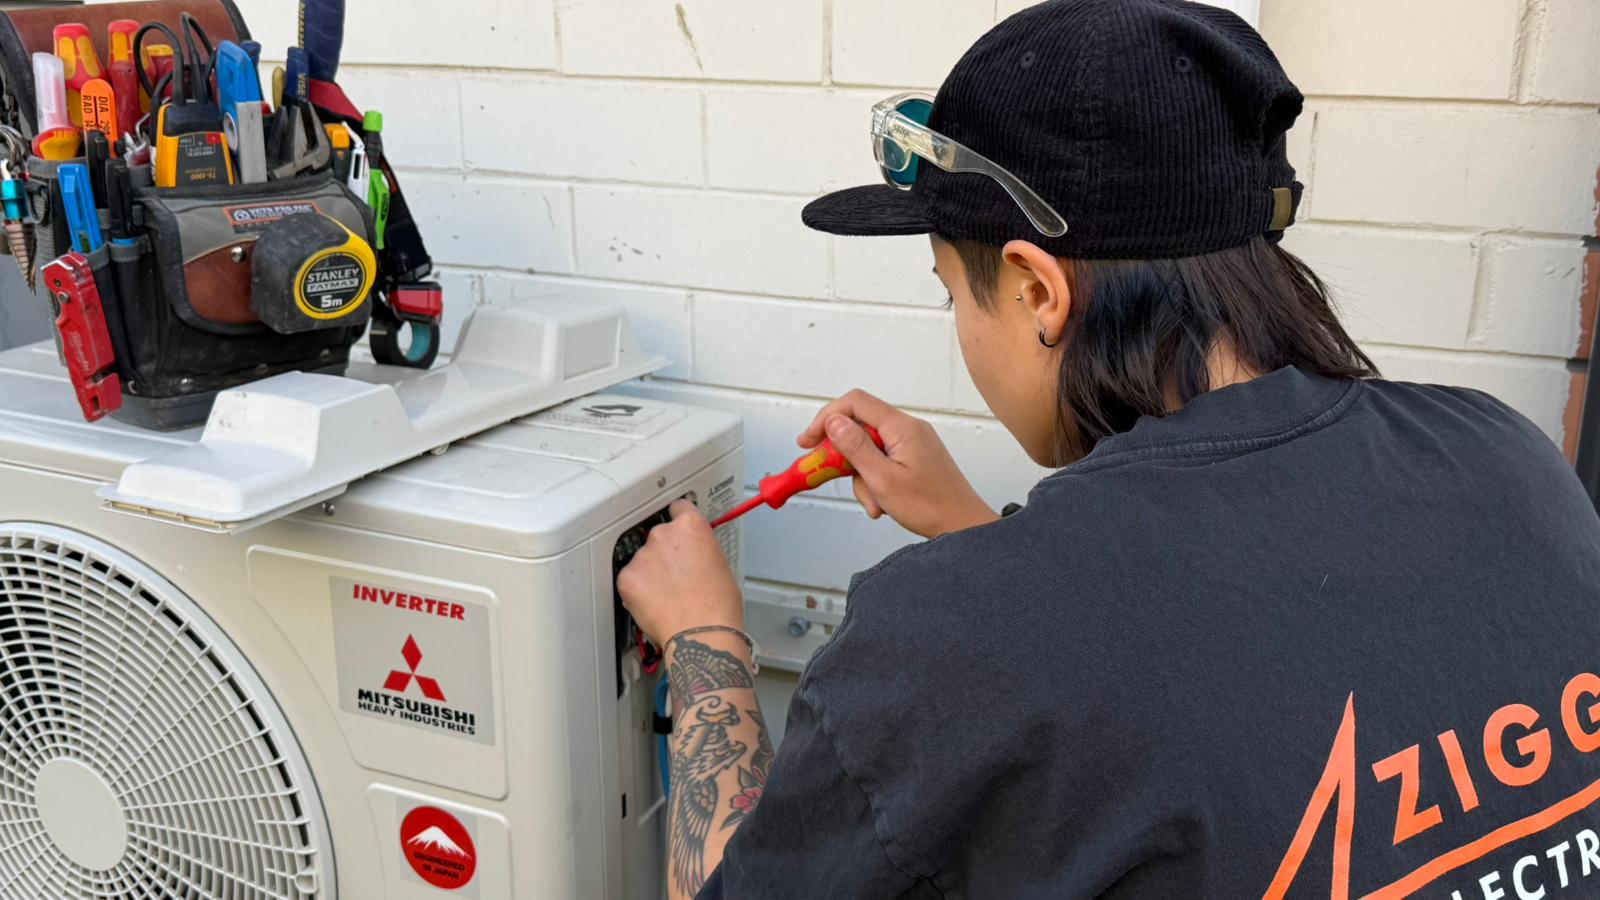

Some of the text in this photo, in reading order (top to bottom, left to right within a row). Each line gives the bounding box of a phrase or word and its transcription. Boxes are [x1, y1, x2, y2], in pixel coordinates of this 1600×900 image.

[82, 95, 93, 114] RAD
[98, 96, 109, 113] DIA
[307, 268, 360, 283] STANLEY
[309, 280, 356, 292] FATMAX
[321, 295, 343, 308] 5m
[352, 584, 466, 621] INVERTER
[357, 689, 476, 726] MITSUBISHI
[358, 701, 476, 735] HEAVY INDUSTRIES
[413, 851, 465, 871] ENGINEERED
[1451, 829, 1600, 900] ECTR
[423, 863, 460, 880] IN JAPAN
